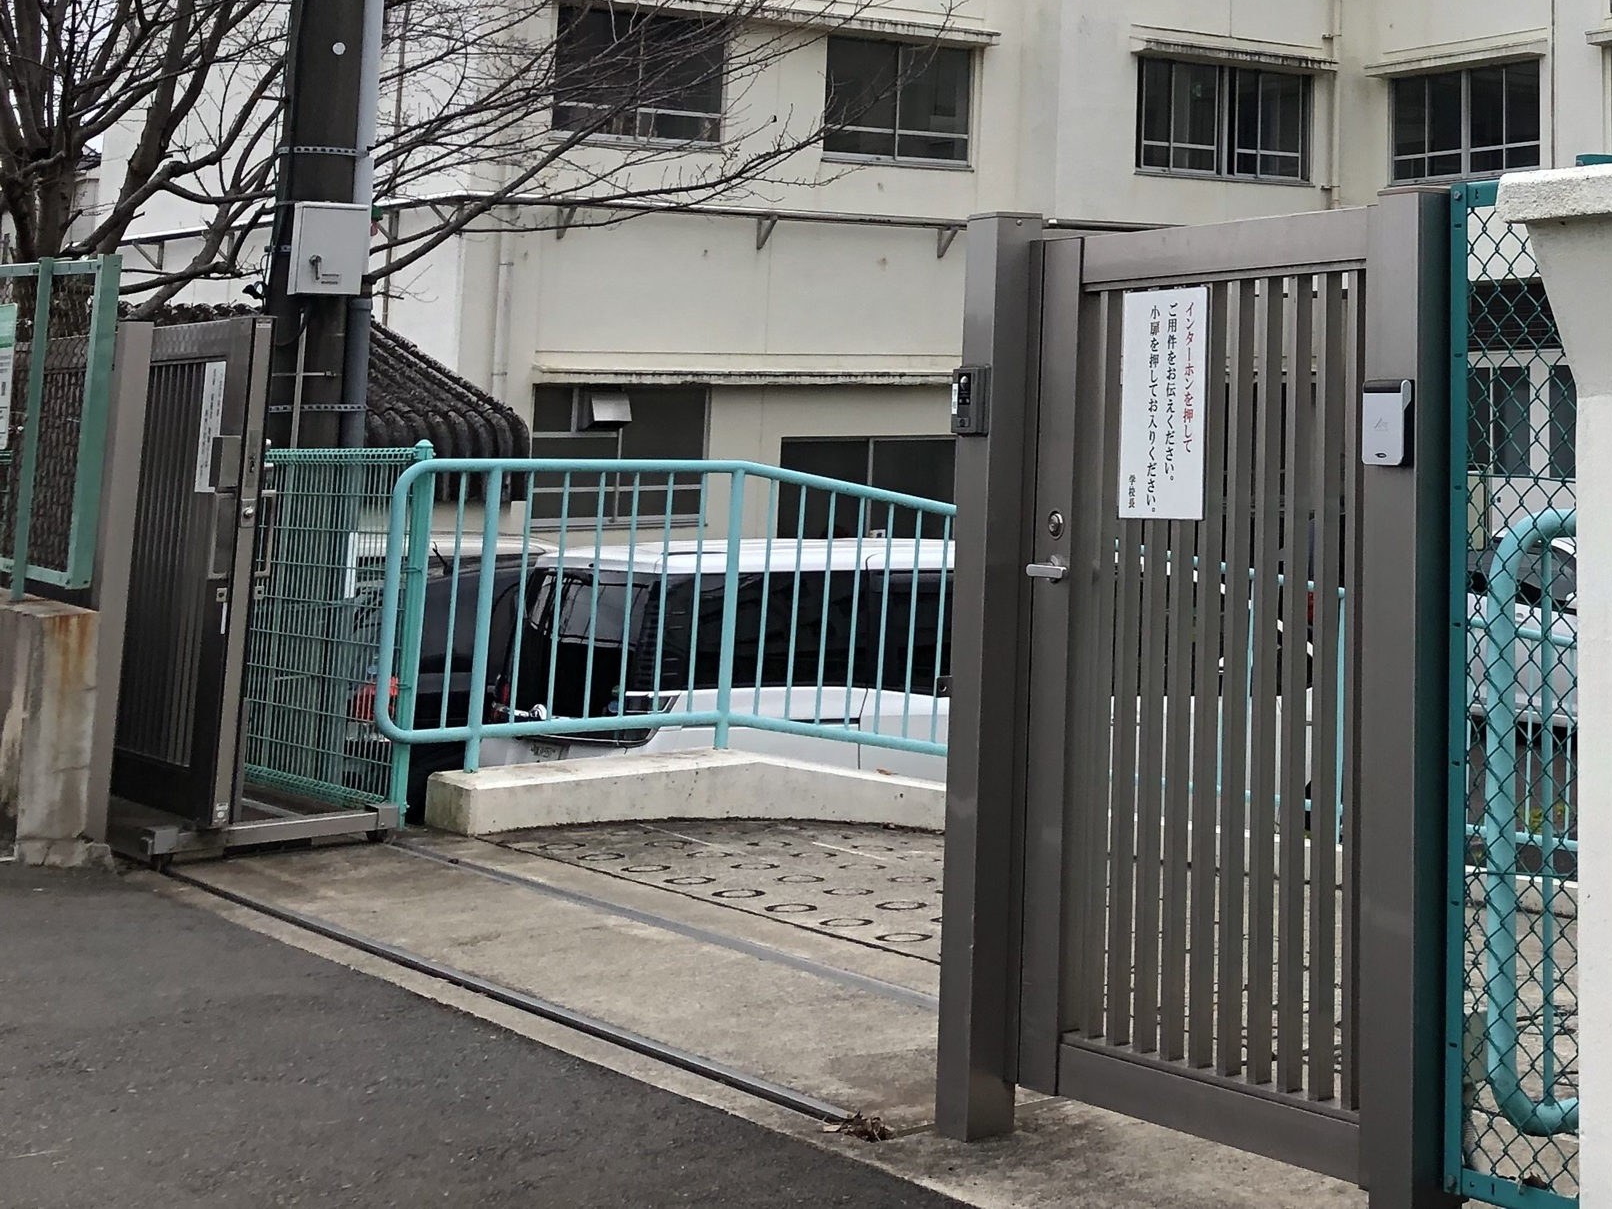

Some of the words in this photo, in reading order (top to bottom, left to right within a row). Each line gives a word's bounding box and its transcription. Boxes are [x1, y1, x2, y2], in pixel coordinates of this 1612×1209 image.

[1146, 305, 1160, 513] 小扉を押してお入りください。
[1164, 302, 1178, 481] ご用件をお伝えください。
[1183, 301, 1195, 453] インターホンを押して
[1127, 474, 1136, 509] 学校長
